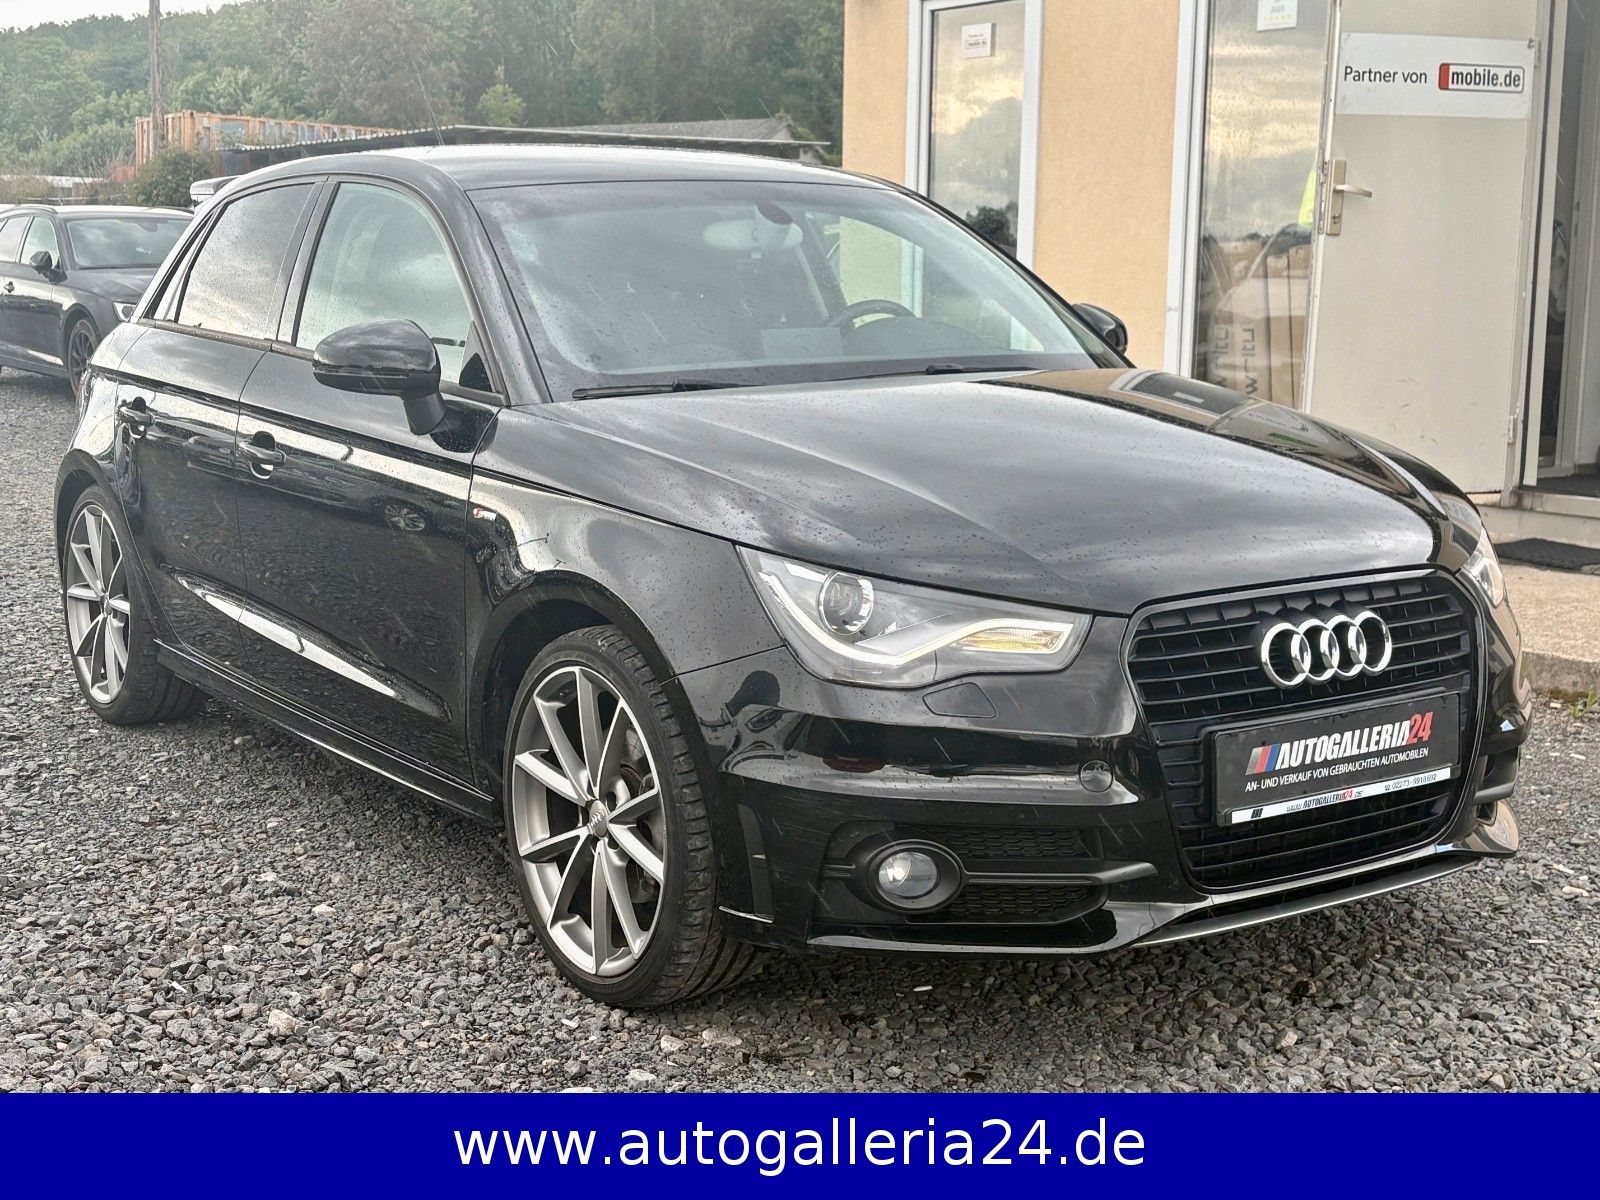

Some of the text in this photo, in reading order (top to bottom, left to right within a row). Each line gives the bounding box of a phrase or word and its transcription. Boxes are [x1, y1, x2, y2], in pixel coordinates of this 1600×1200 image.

[1344, 66, 1521, 88] Partner von mobile.de
[1275, 711, 1433, 771] AUTOGALLERIA24
[1245, 746, 1429, 793] AN- UND VERKAUF VON GEBRAUCHTEN AUTOMOBILEN
